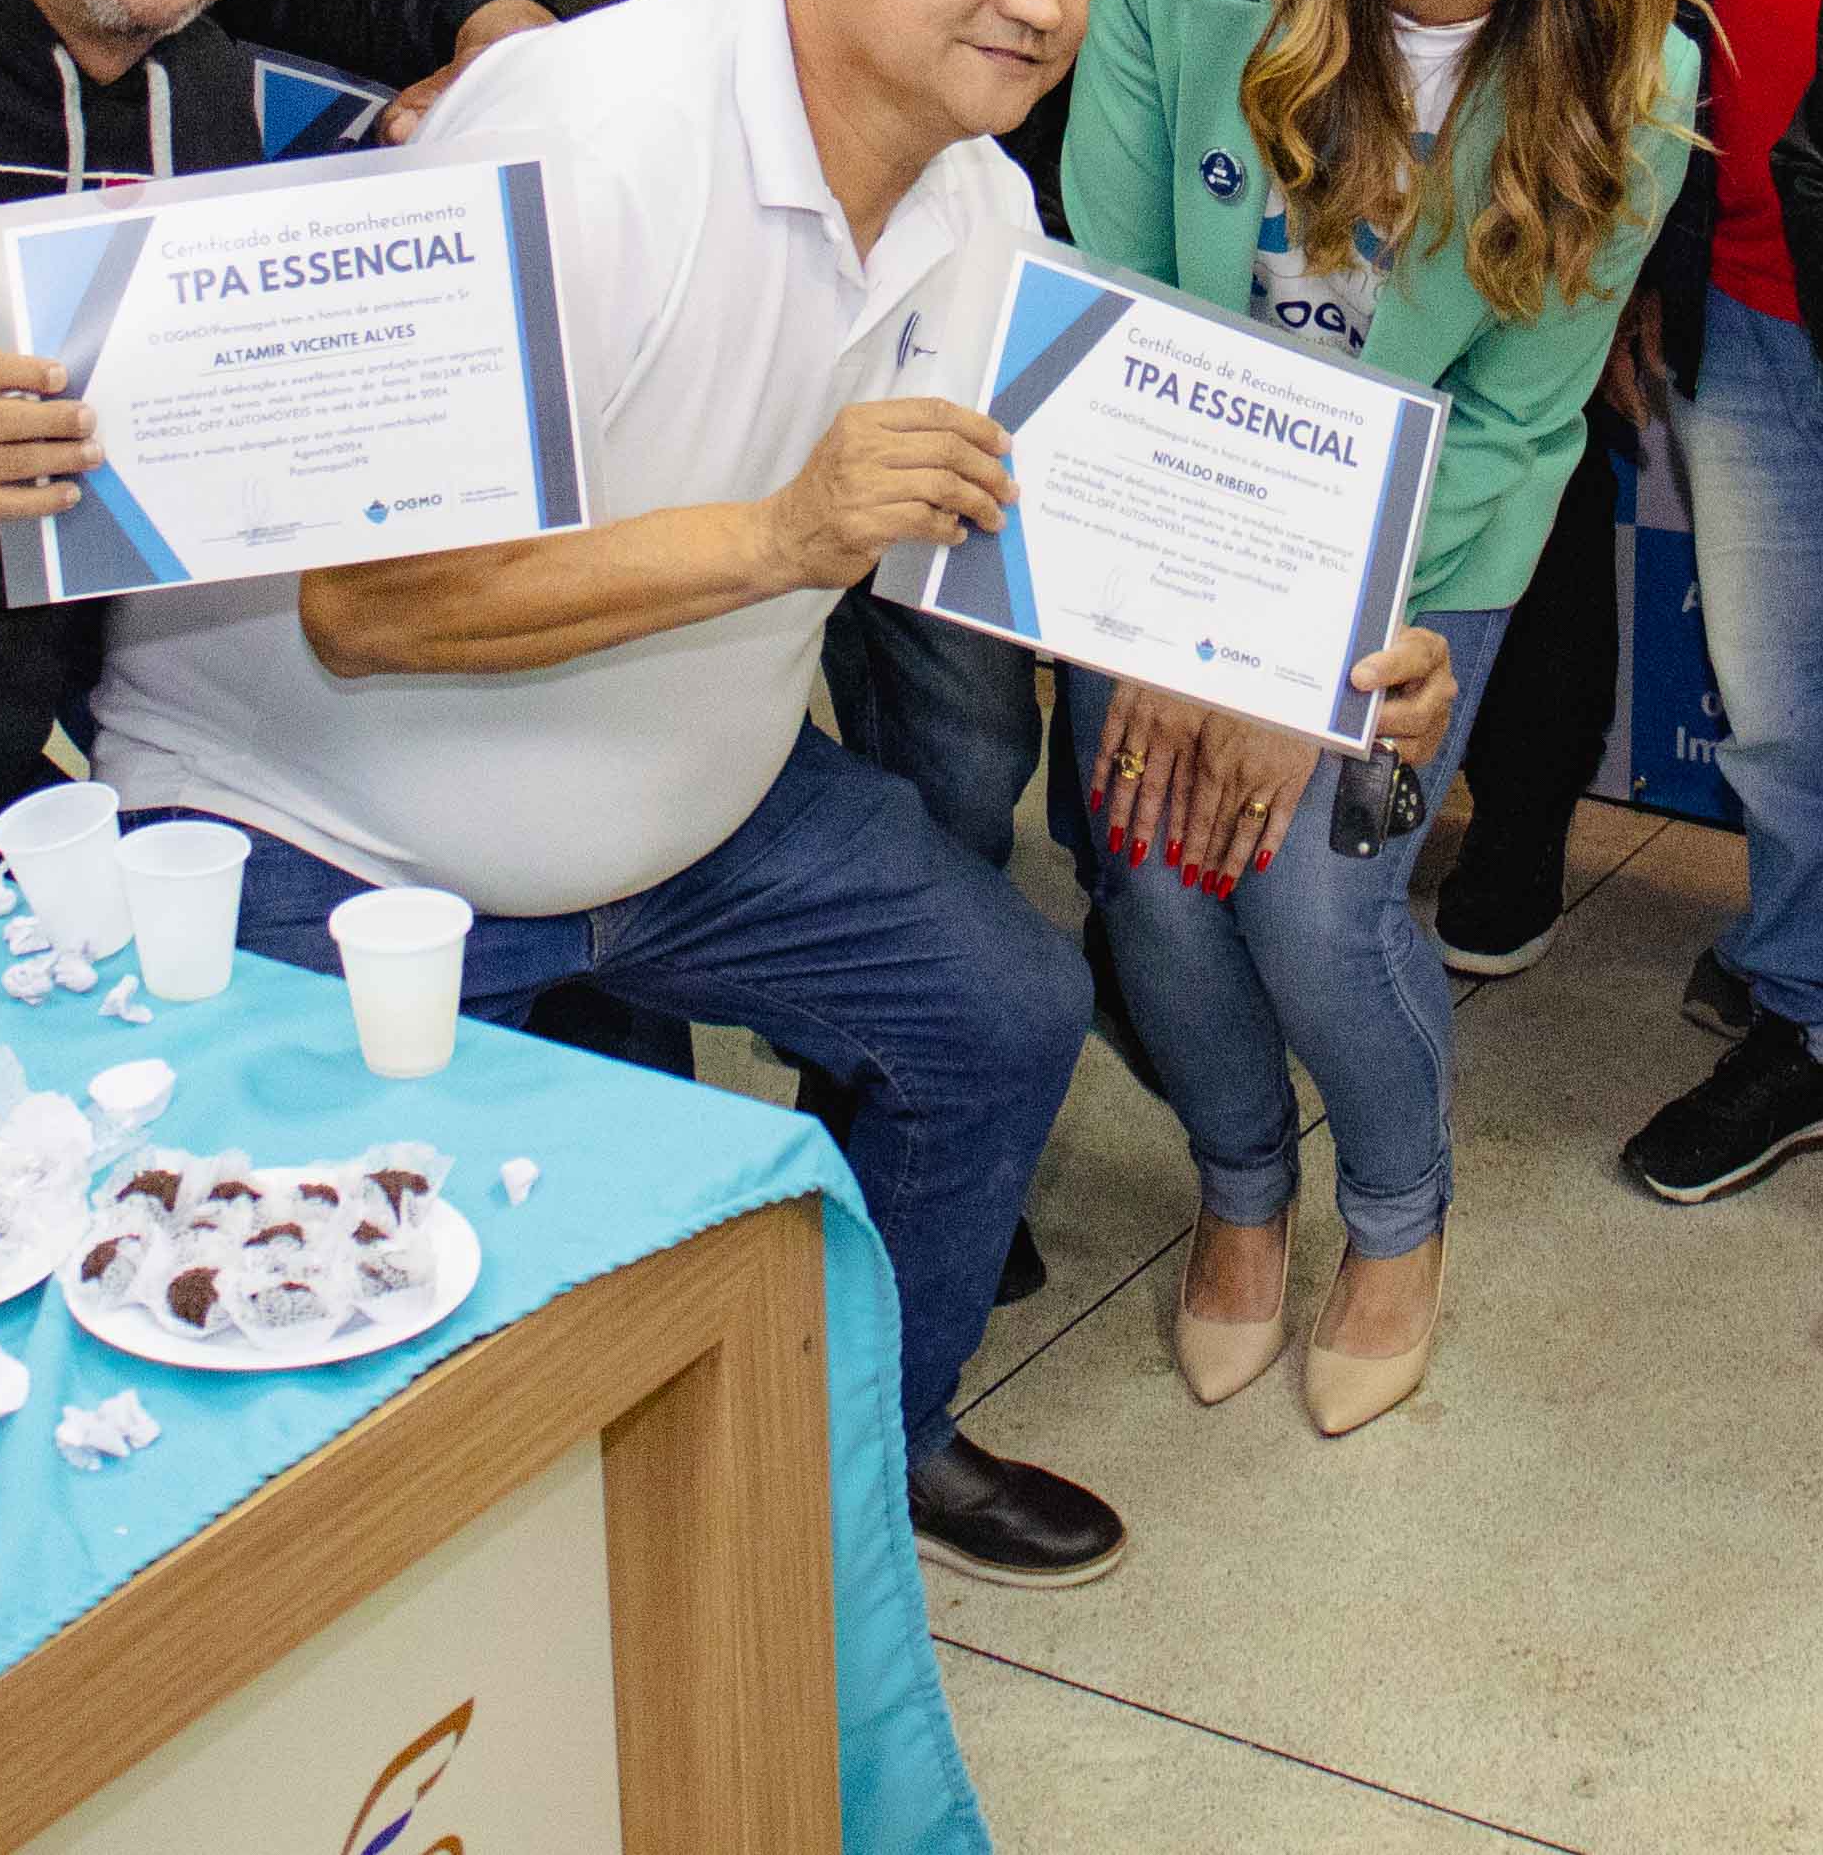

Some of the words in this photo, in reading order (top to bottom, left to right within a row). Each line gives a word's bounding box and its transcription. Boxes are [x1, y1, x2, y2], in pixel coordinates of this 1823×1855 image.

[161, 231, 271, 260] Certificado
[278, 225, 301, 245] de
[308, 203, 466, 239] Reconhecimento
[168, 265, 249, 304] TPA
[259, 232, 475, 293] ESSENCIAL
[213, 343, 286, 367] ALTAMIR
[290, 331, 360, 355] VICENTE
[364, 323, 416, 344] ALVES
[1128, 328, 1212, 373] Certificado
[1216, 360, 1235, 381] de
[1241, 368, 1364, 426] Reconhecimento
[1124, 356, 1179, 405] TPA
[1188, 381, 1358, 467] ESSENCIAL
[1152, 449, 1212, 482] NIVALDO
[1216, 465, 1267, 500] RIBEIRO
[393, 494, 443, 512] OGMO
[1220, 647, 1261, 668] OGMO
